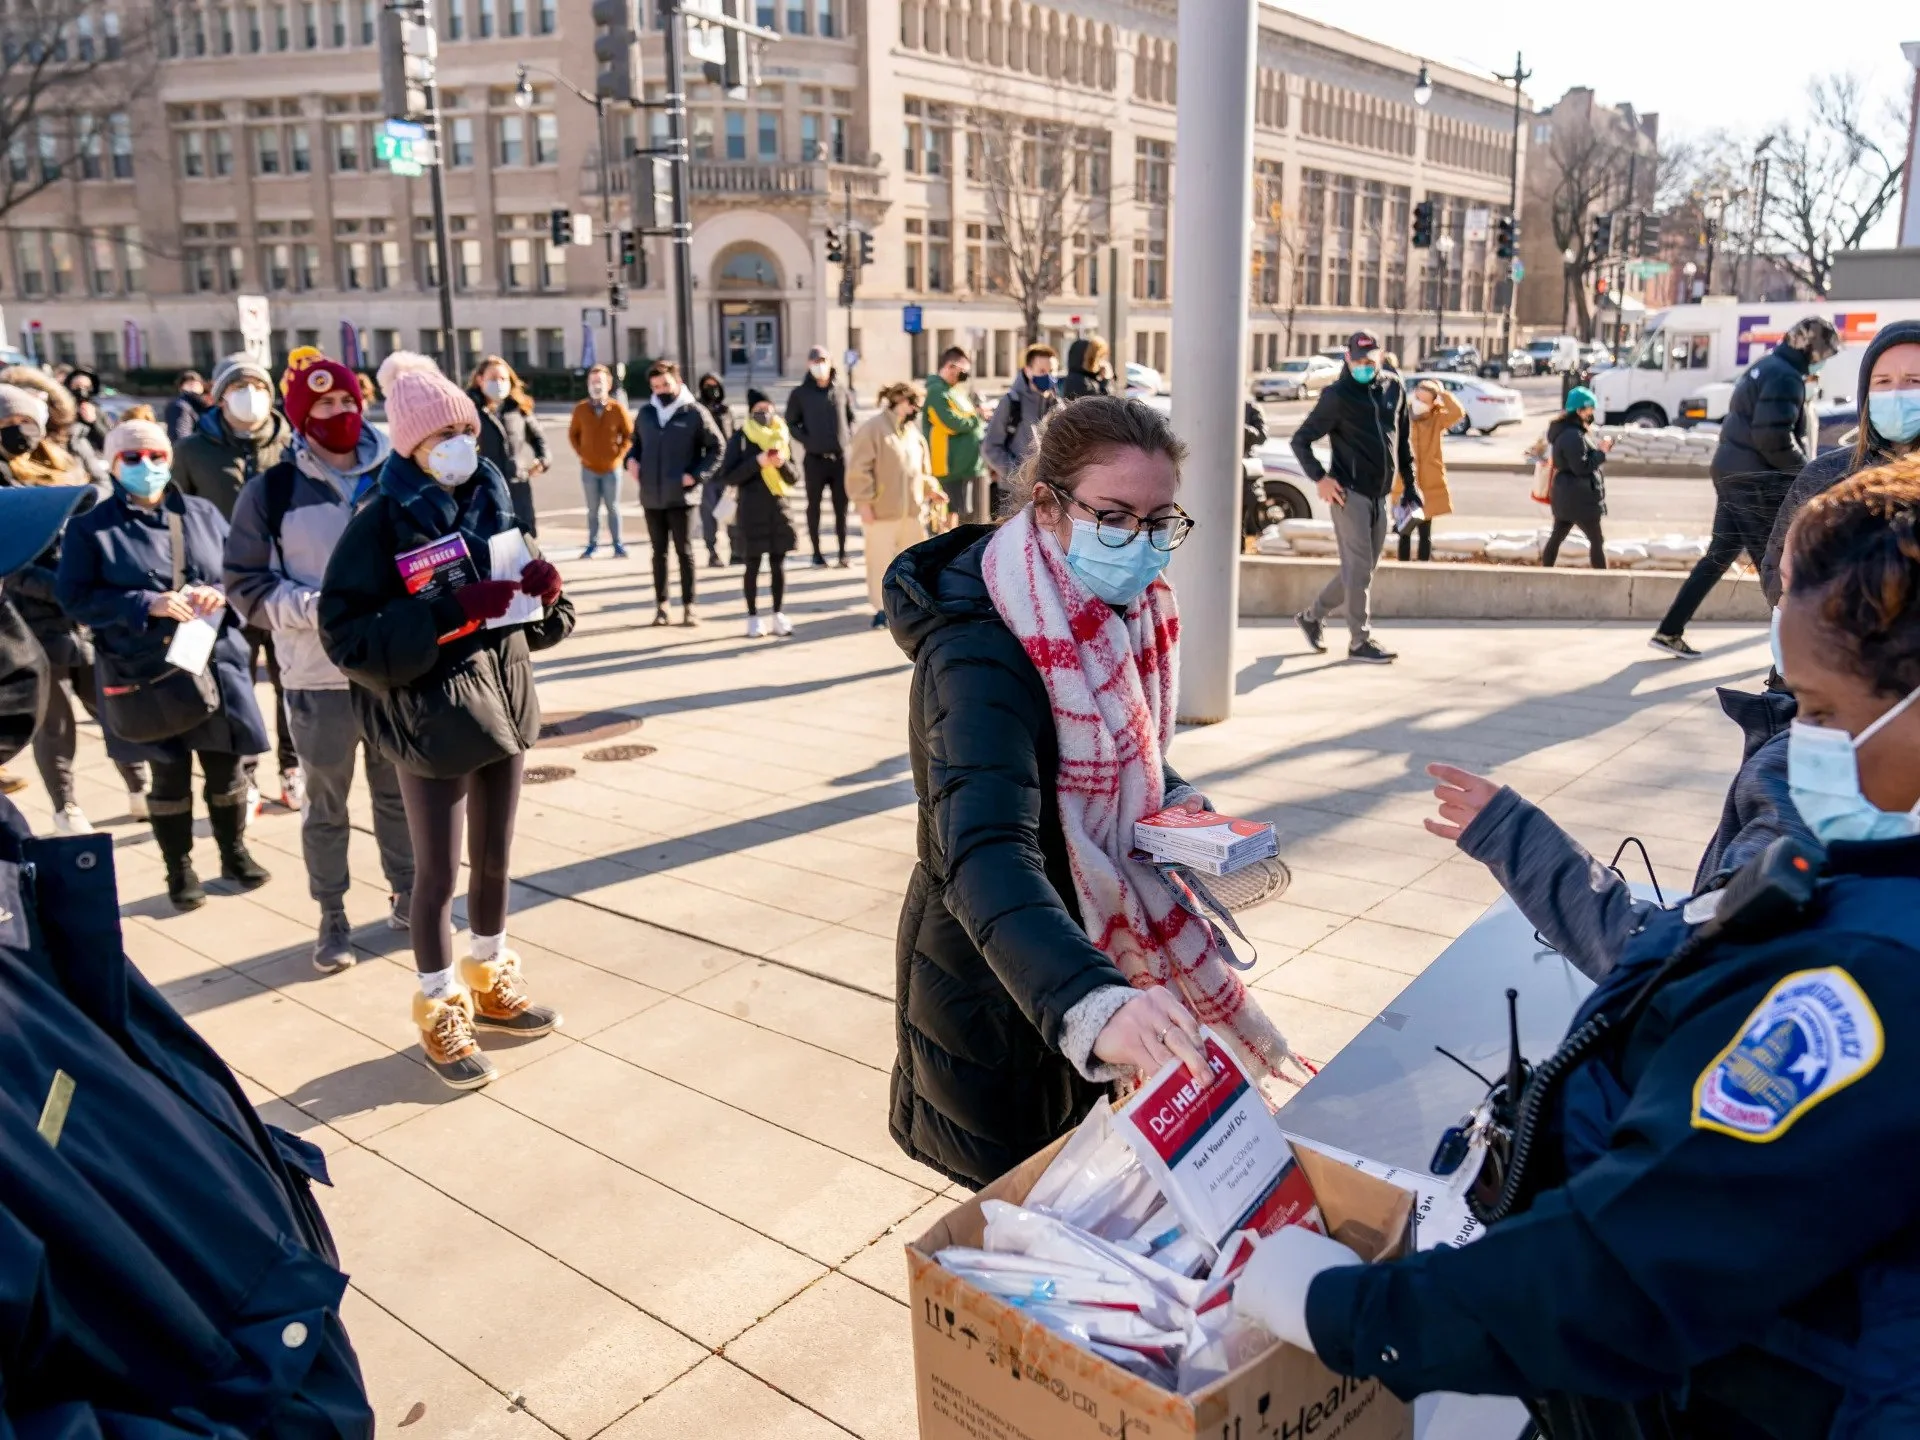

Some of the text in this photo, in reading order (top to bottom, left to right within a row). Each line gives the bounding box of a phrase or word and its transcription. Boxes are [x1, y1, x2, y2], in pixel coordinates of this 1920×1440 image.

[409, 556, 430, 574] JOHN
[429, 547, 457, 565] GREEN
[1149, 1055, 1226, 1135] DC HEAH
[1192, 1110, 1248, 1170] Test Yourself DC
[1208, 1181, 1218, 1192] At
[1214, 1162, 1235, 1183] Home
[1231, 1134, 1261, 1165] COVID-19
[1226, 1157, 1256, 1189] Testing Kit
[1453, 1214, 1478, 1248] porar
